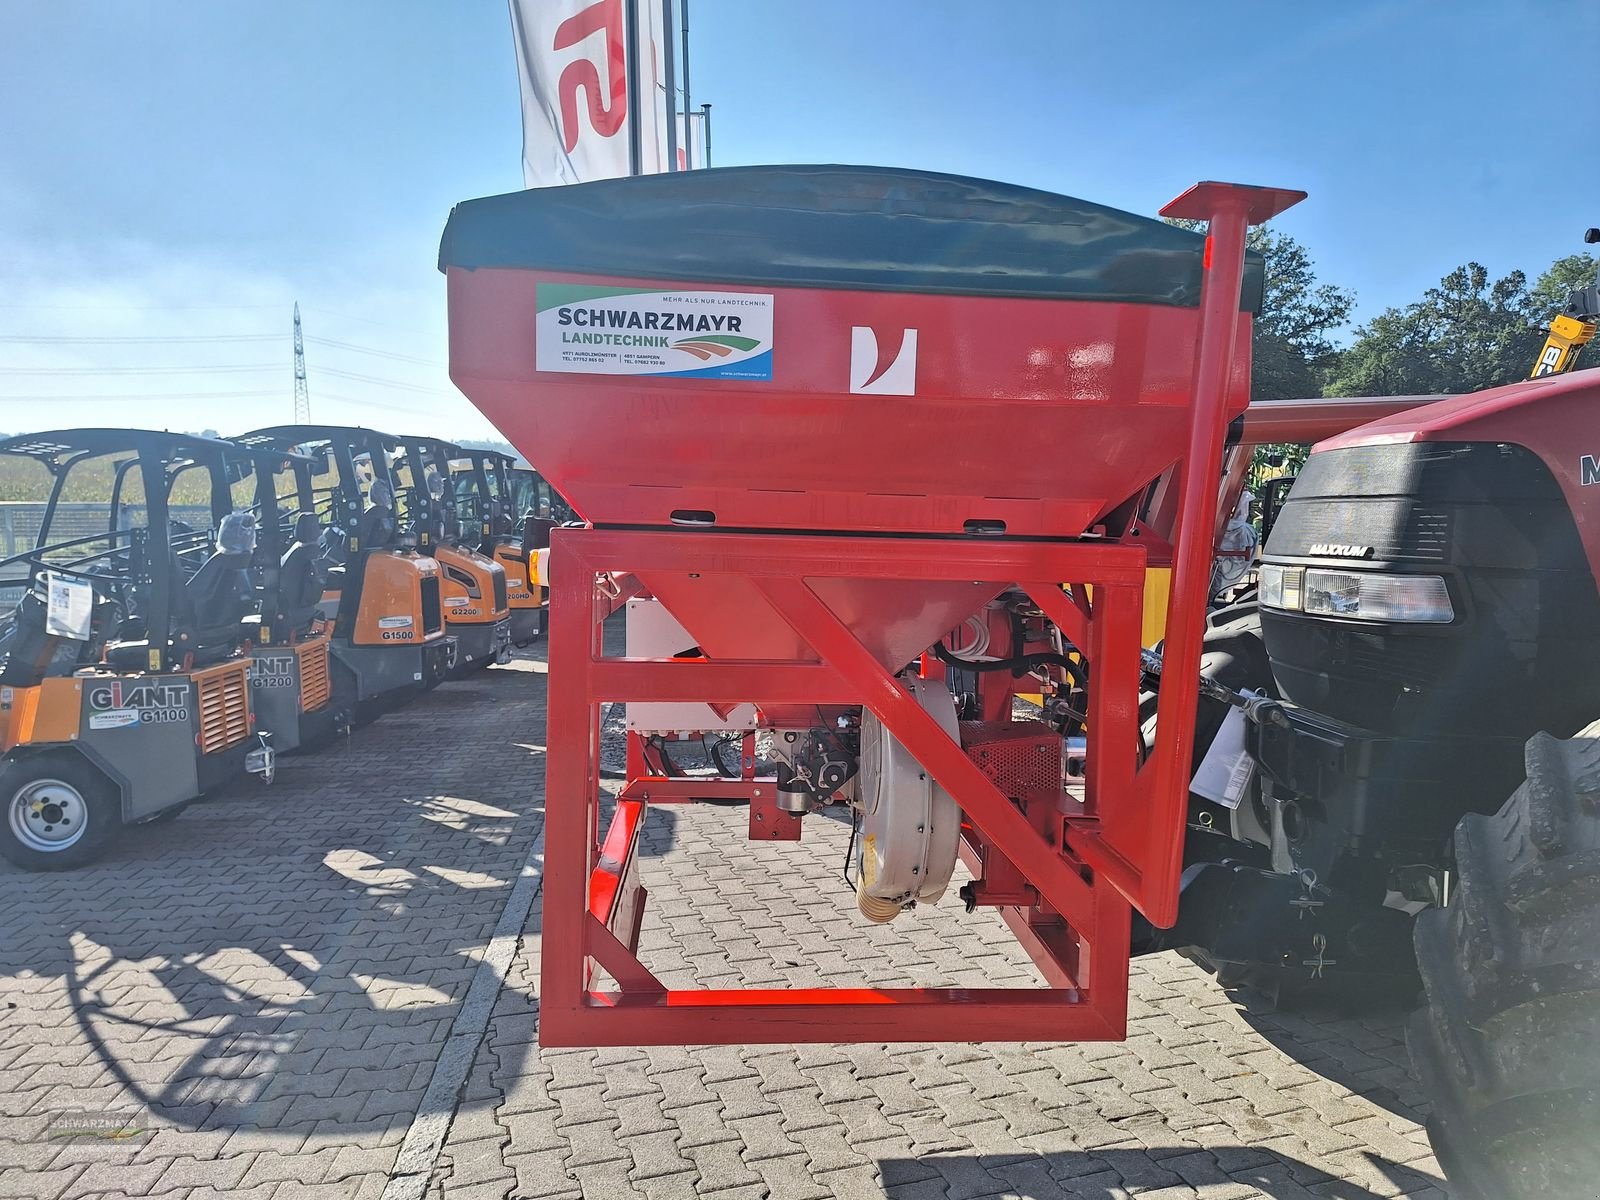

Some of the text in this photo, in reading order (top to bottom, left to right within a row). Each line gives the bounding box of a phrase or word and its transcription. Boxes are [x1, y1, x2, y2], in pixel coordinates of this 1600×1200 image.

[558, 307, 742, 332] SCHWARZMAYR
[562, 331, 670, 348] LANDTECHNIK
[1309, 543, 1369, 557] MAXXUM
[507, 592, 530, 600] 200HD
[382, 631, 414, 641] G1500
[252, 676, 293, 688] G1200
[140, 708, 187, 724] G1100
